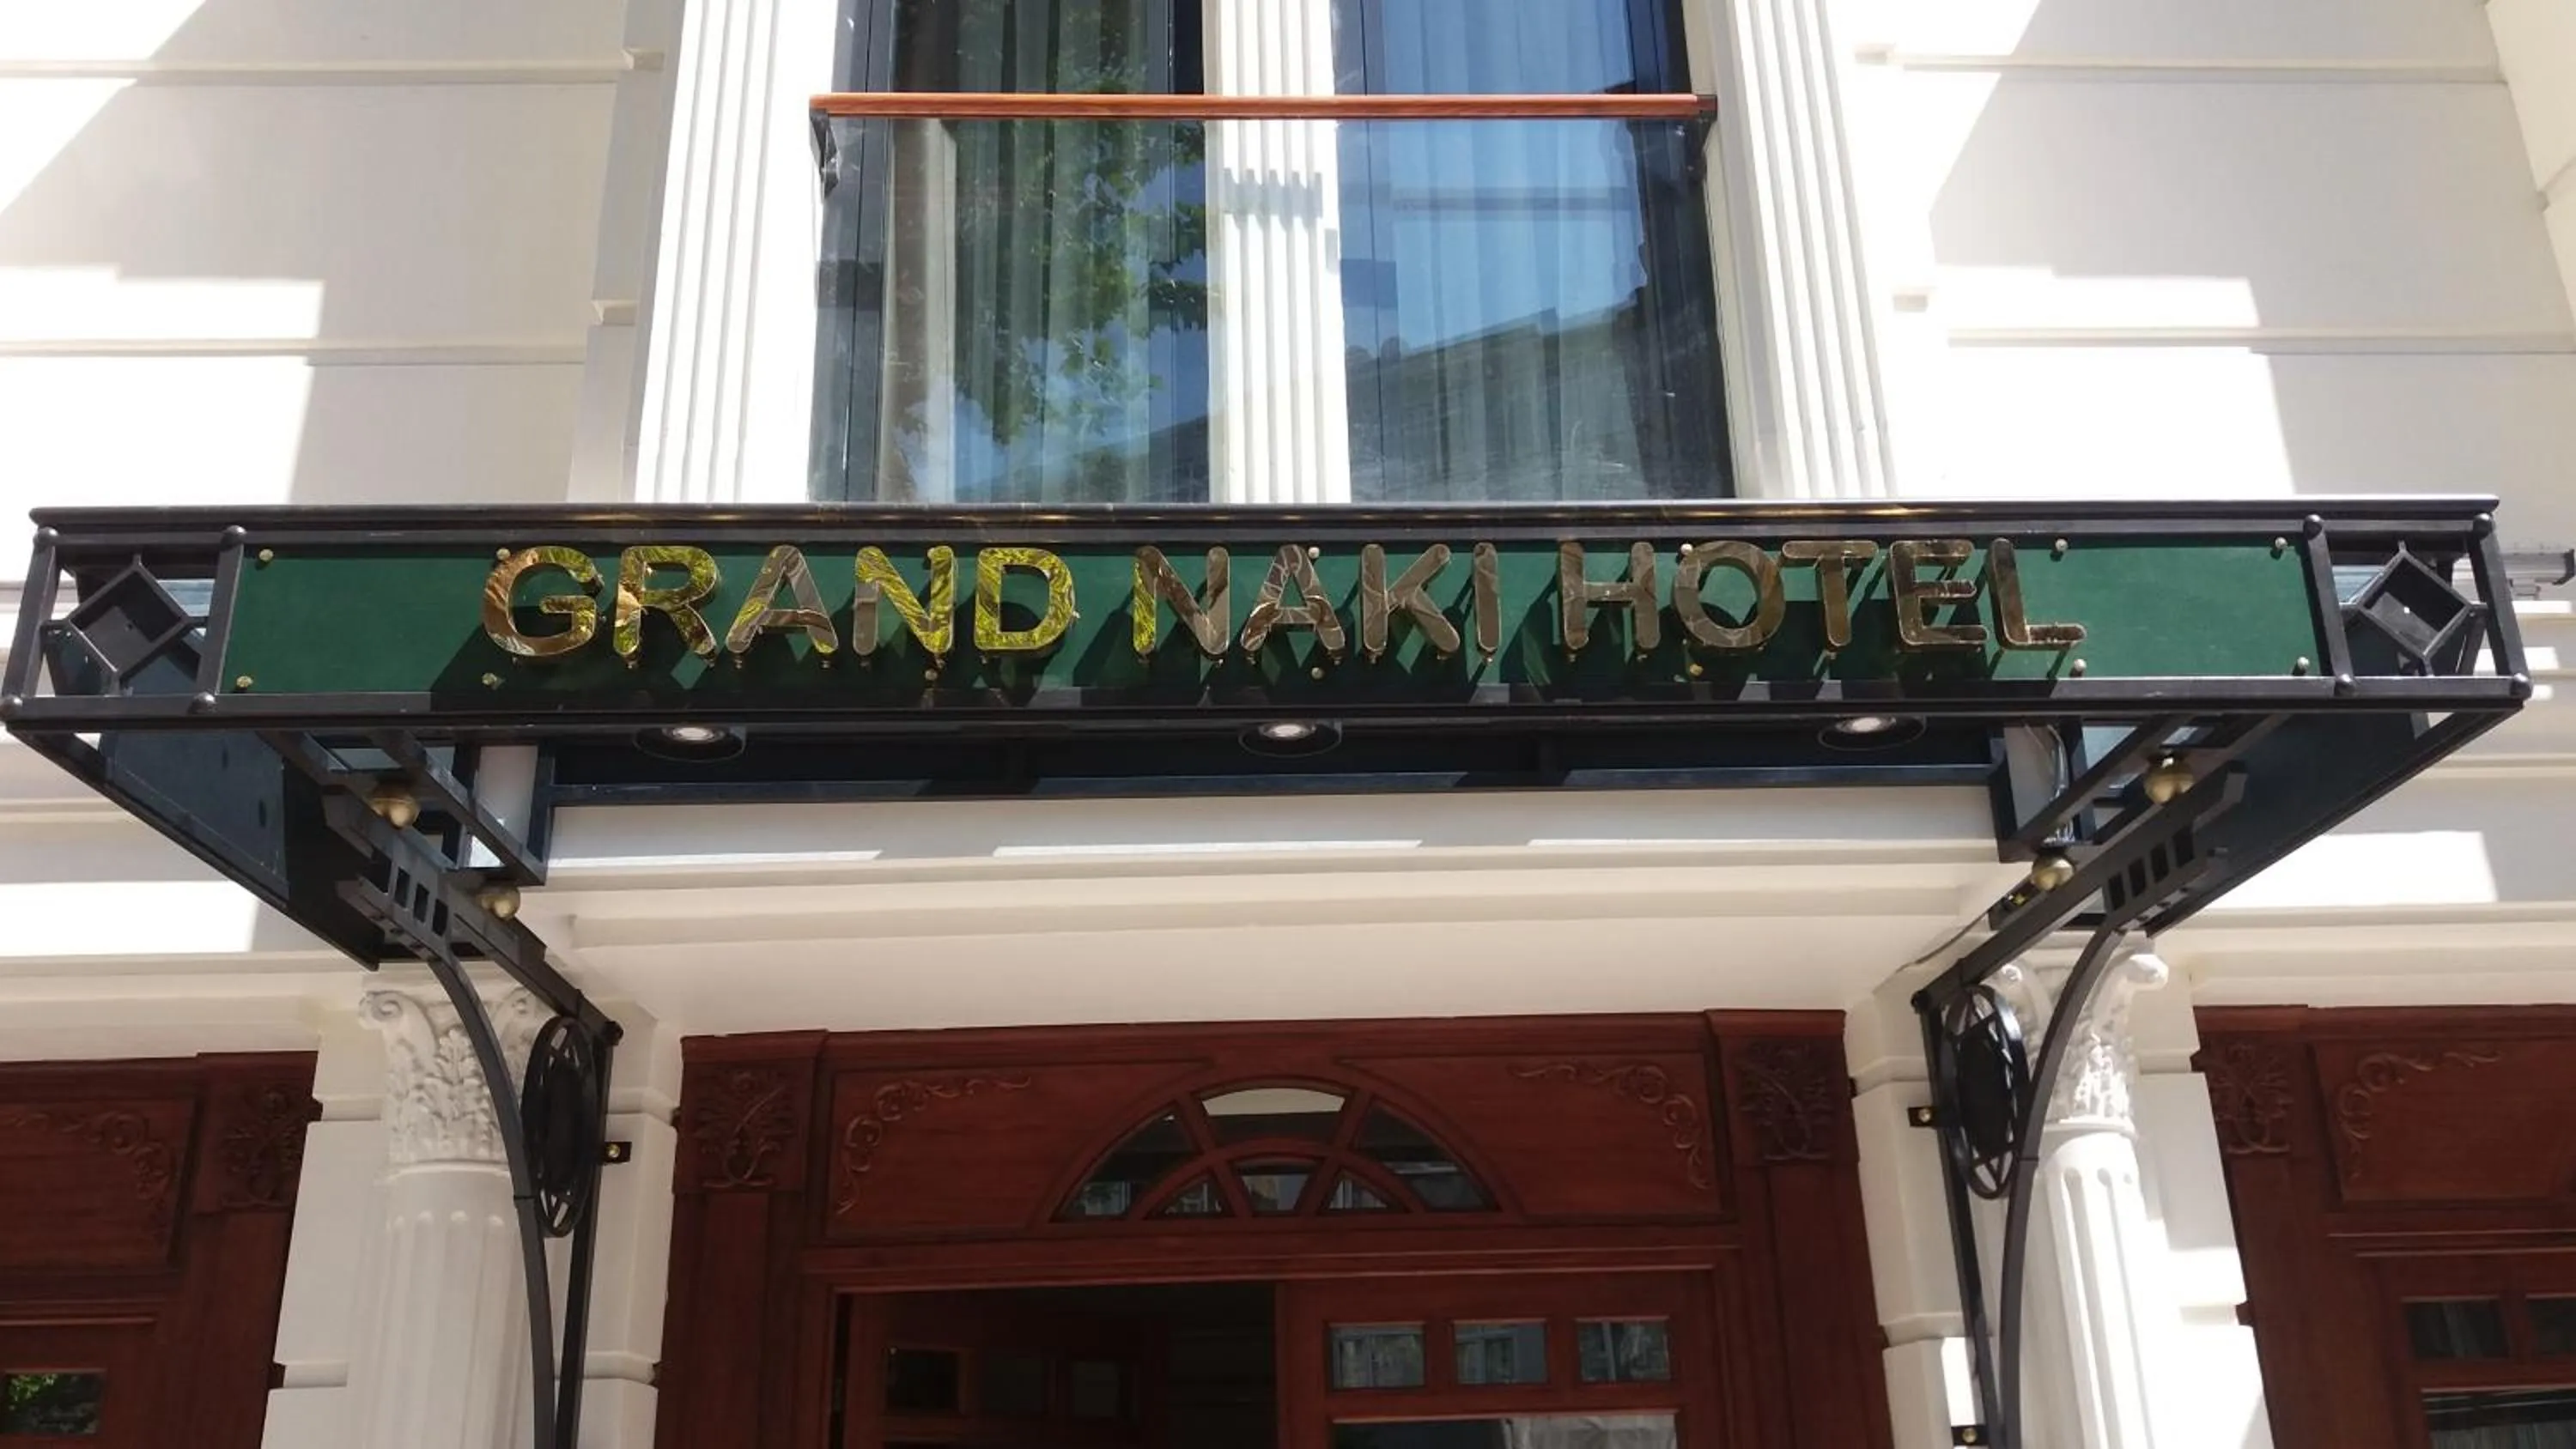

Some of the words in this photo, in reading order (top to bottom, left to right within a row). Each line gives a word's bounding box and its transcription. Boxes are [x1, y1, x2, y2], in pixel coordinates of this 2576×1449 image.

[481, 544, 1077, 658] GRAND
[1133, 543, 1502, 656] NAKI
[1556, 537, 2087, 651] HOTEL
